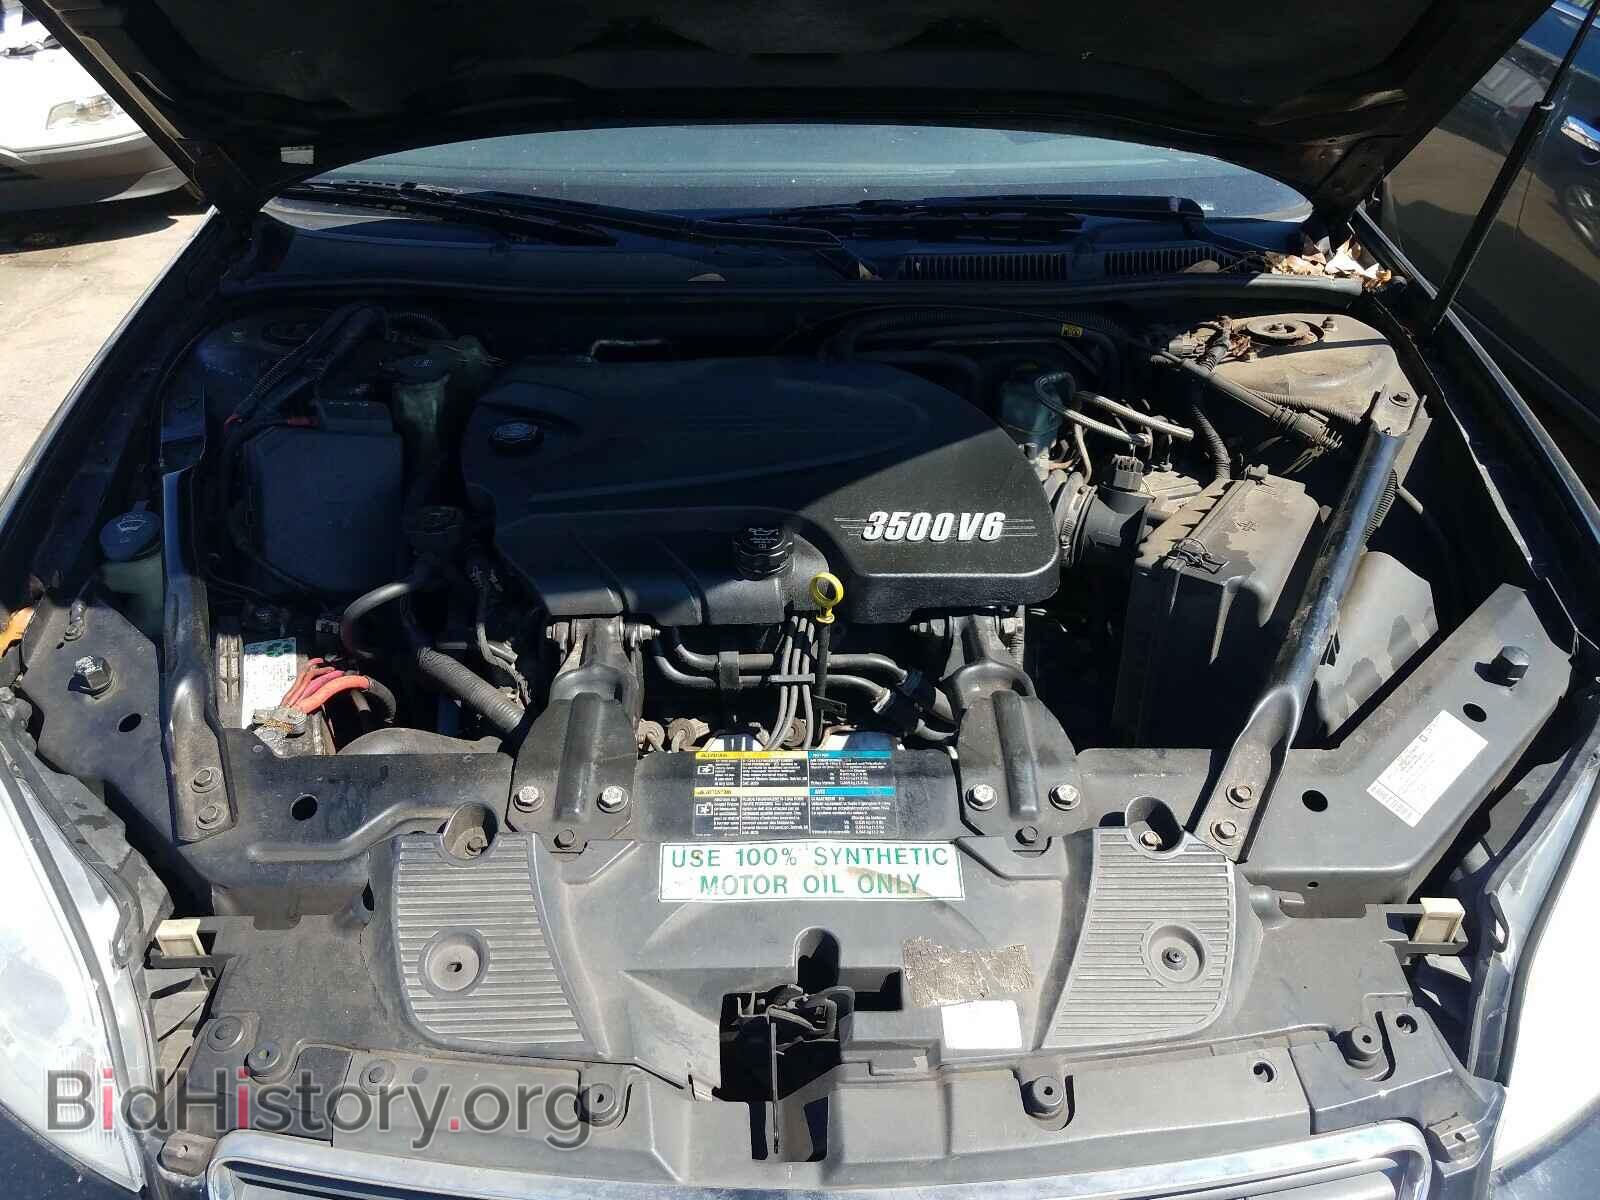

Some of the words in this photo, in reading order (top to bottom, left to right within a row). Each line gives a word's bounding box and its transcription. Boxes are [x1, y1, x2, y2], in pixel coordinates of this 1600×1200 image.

[862, 511, 954, 541] 3500
[957, 512, 1006, 541] V6
[671, 848, 721, 867] USE
[735, 847, 798, 866] 100%
[814, 846, 949, 866] SYNTHETIC
[700, 874, 789, 896] MOTOR
[803, 874, 845, 895] OIL
[857, 872, 921, 895] ONLY
